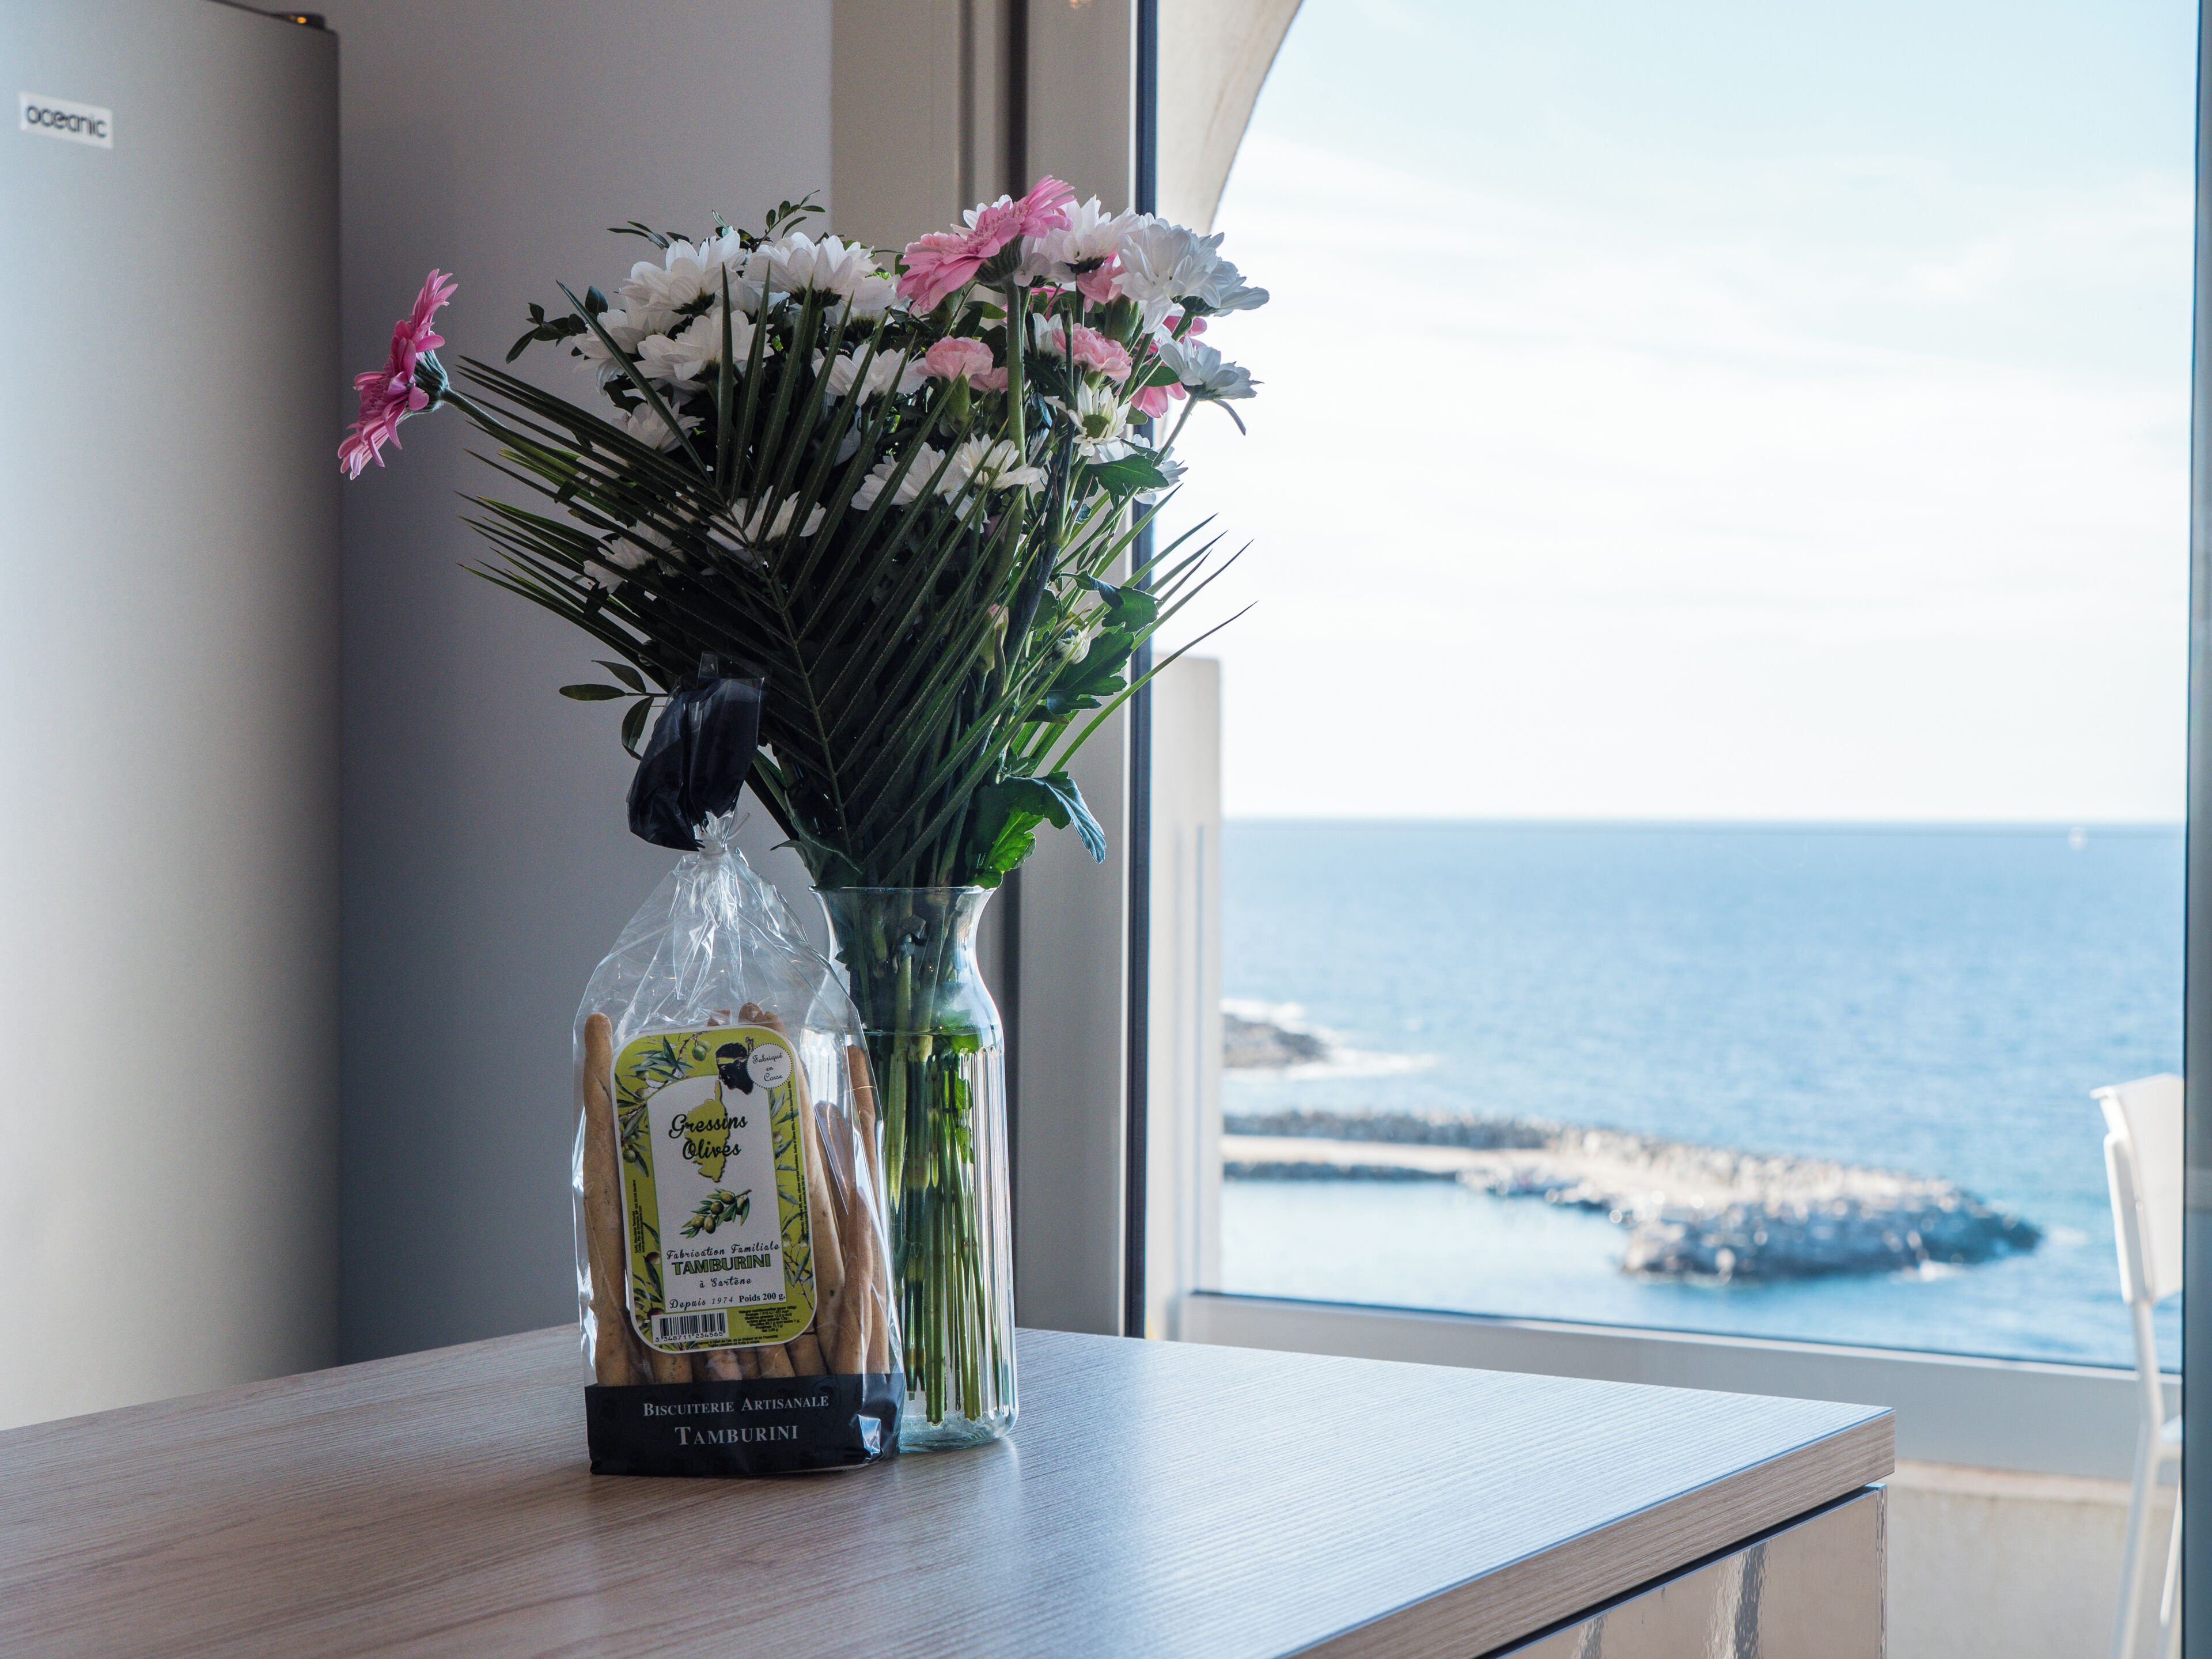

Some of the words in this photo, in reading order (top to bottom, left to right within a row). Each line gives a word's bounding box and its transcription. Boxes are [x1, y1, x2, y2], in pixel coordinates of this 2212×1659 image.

[26, 104, 108, 138] oceanic
[752, 1052, 783, 1065] Fabriqué
[764, 1073, 783, 1082] Corse
[668, 1112, 748, 1139] Gressins
[682, 1139, 741, 1160] Olives
[666, 1247, 725, 1260] Fabrication
[730, 1241, 781, 1254] Familiale
[671, 1253, 771, 1275] TAMBURINI
[699, 1279, 705, 1289] à
[669, 1298, 706, 1311] Depuis
[711, 1296, 734, 1305] 1974
[738, 1294, 761, 1303] Poids
[762, 1292, 777, 1301] 200
[642, 1400, 734, 1417] BISCUITERIE
[741, 1395, 830, 1411] ARTISANALE
[675, 1425, 799, 1446] TAMBURINI
